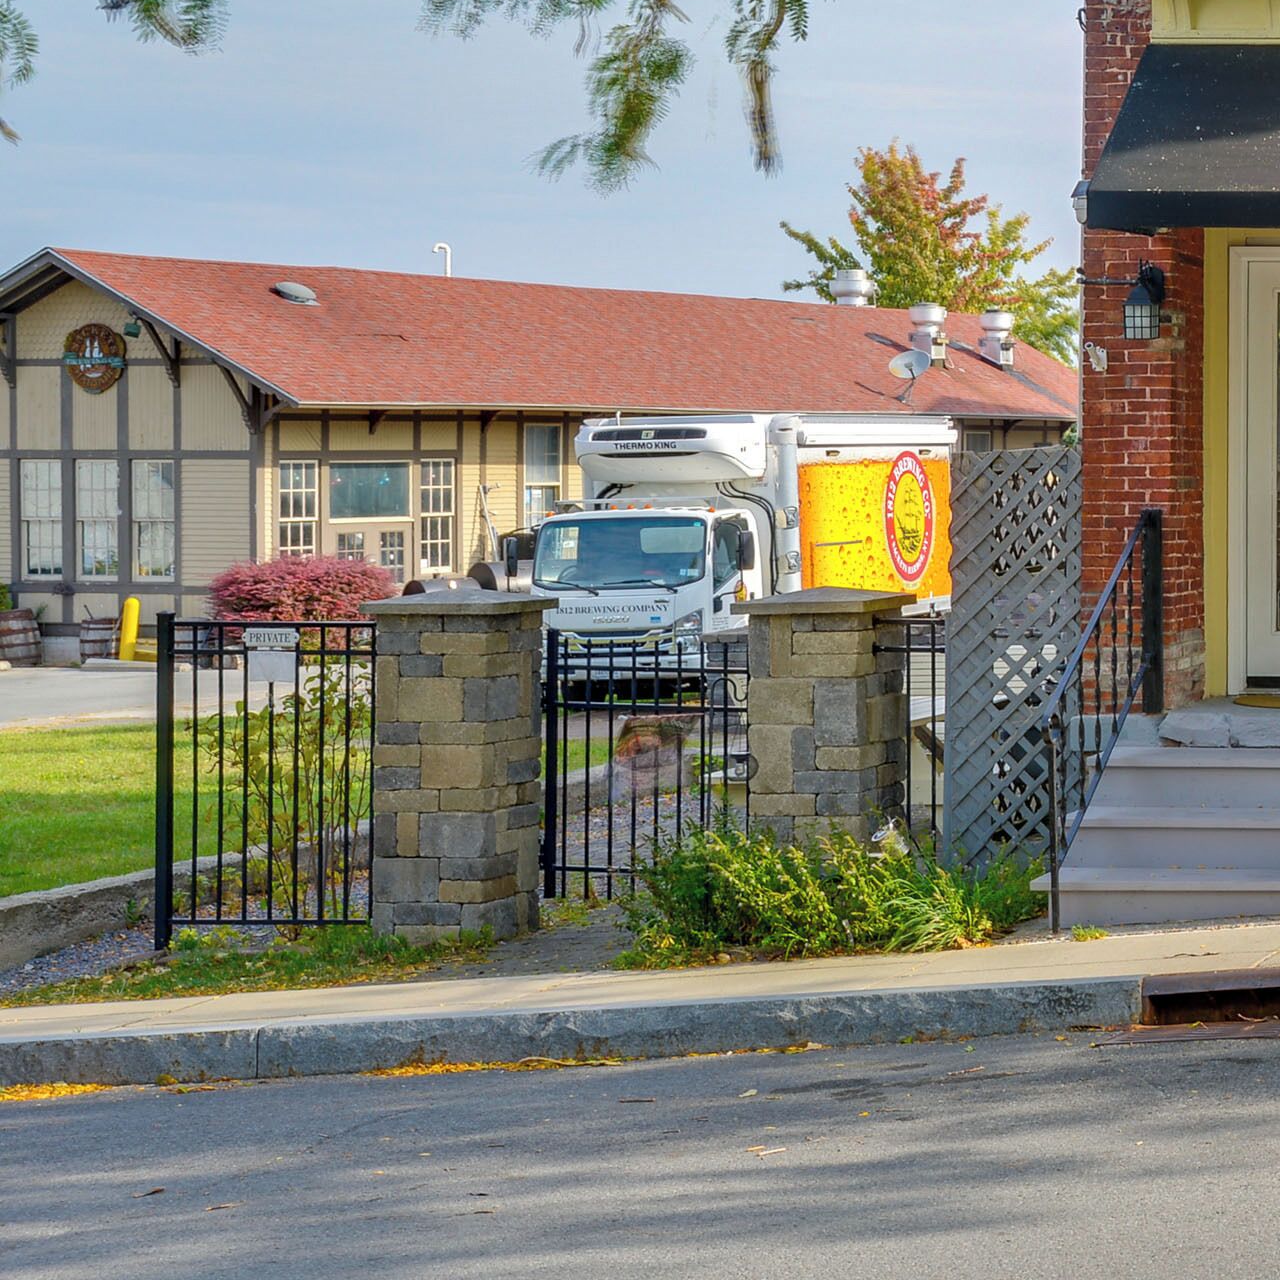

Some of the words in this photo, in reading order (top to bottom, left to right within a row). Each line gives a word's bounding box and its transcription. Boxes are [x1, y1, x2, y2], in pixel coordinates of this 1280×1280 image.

[614, 442, 653, 450] THERMO
[654, 441, 677, 449] KING
[886, 481, 897, 518] 1812
[893, 457, 925, 488] BREWING
[556, 606, 573, 615] 1812
[574, 605, 620, 614] BREWING
[621, 603, 670, 613] COMPANY
[592, 615, 631, 625] ISUZU
[249, 632, 292, 643] PRIVATE
